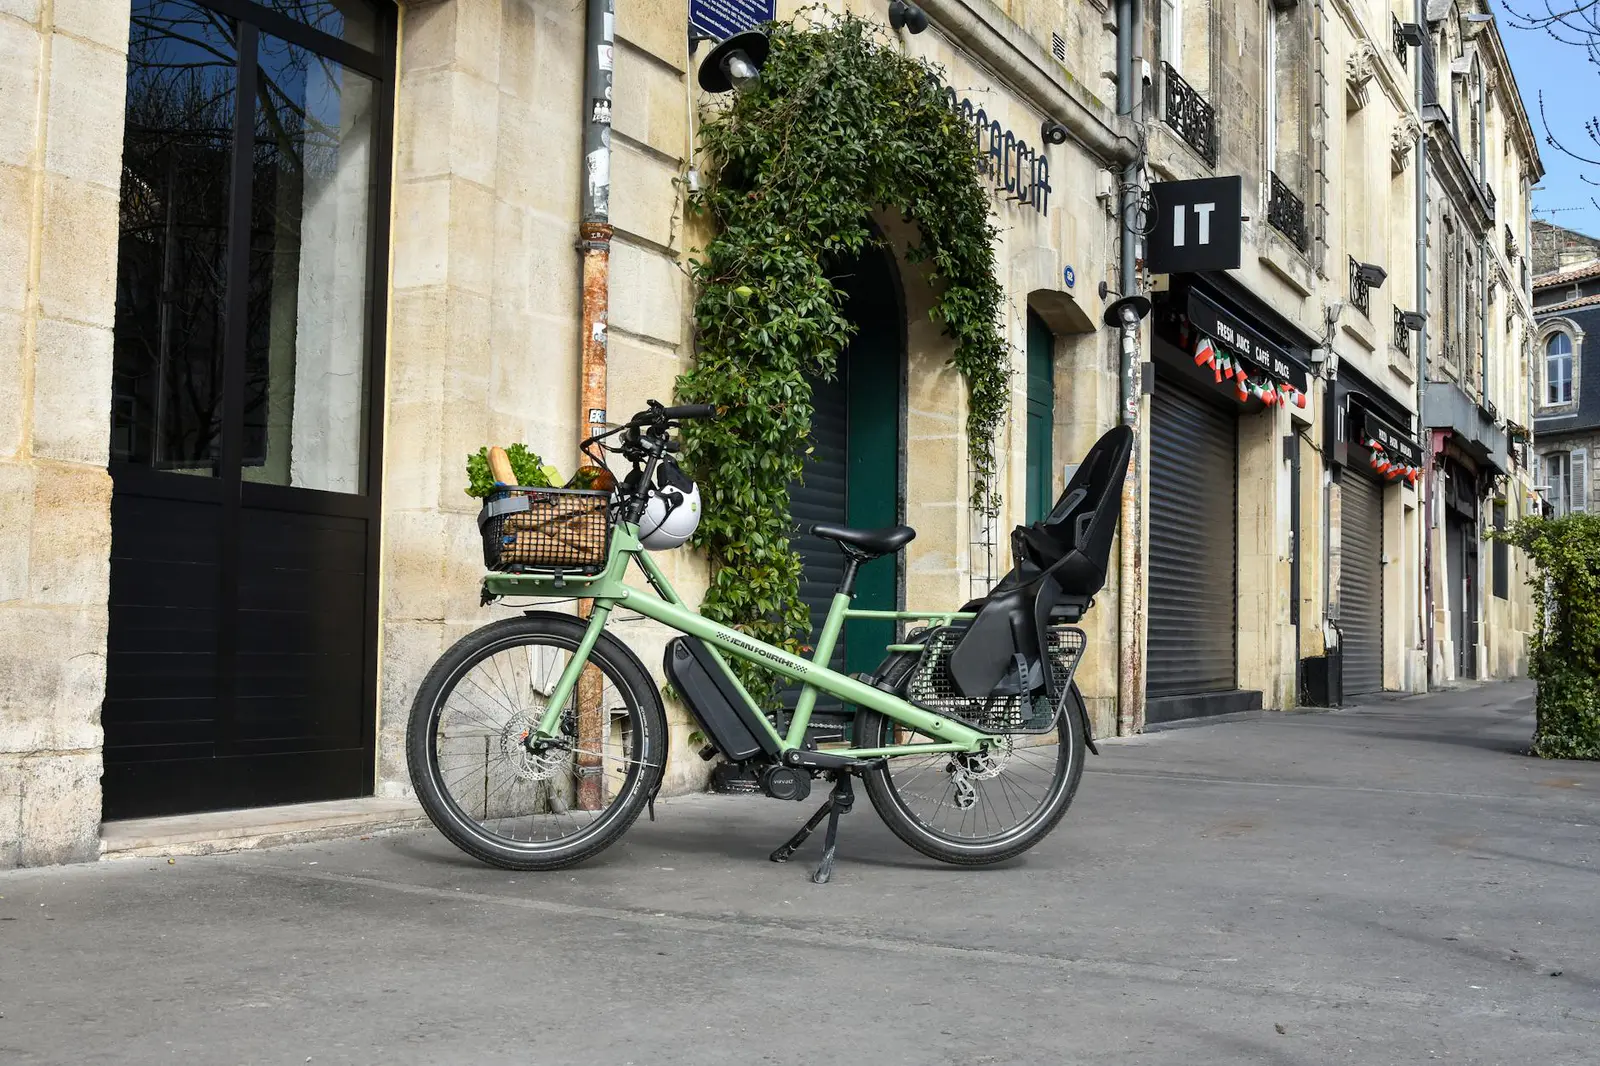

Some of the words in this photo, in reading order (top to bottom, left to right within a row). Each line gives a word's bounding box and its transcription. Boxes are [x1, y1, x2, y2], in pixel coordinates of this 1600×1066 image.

[1173, 202, 1215, 247] IT
[1216, 320, 1235, 344] FRESH
[1236, 333, 1251, 354] JUICE
[1274, 358, 1290, 380] DOLCE
